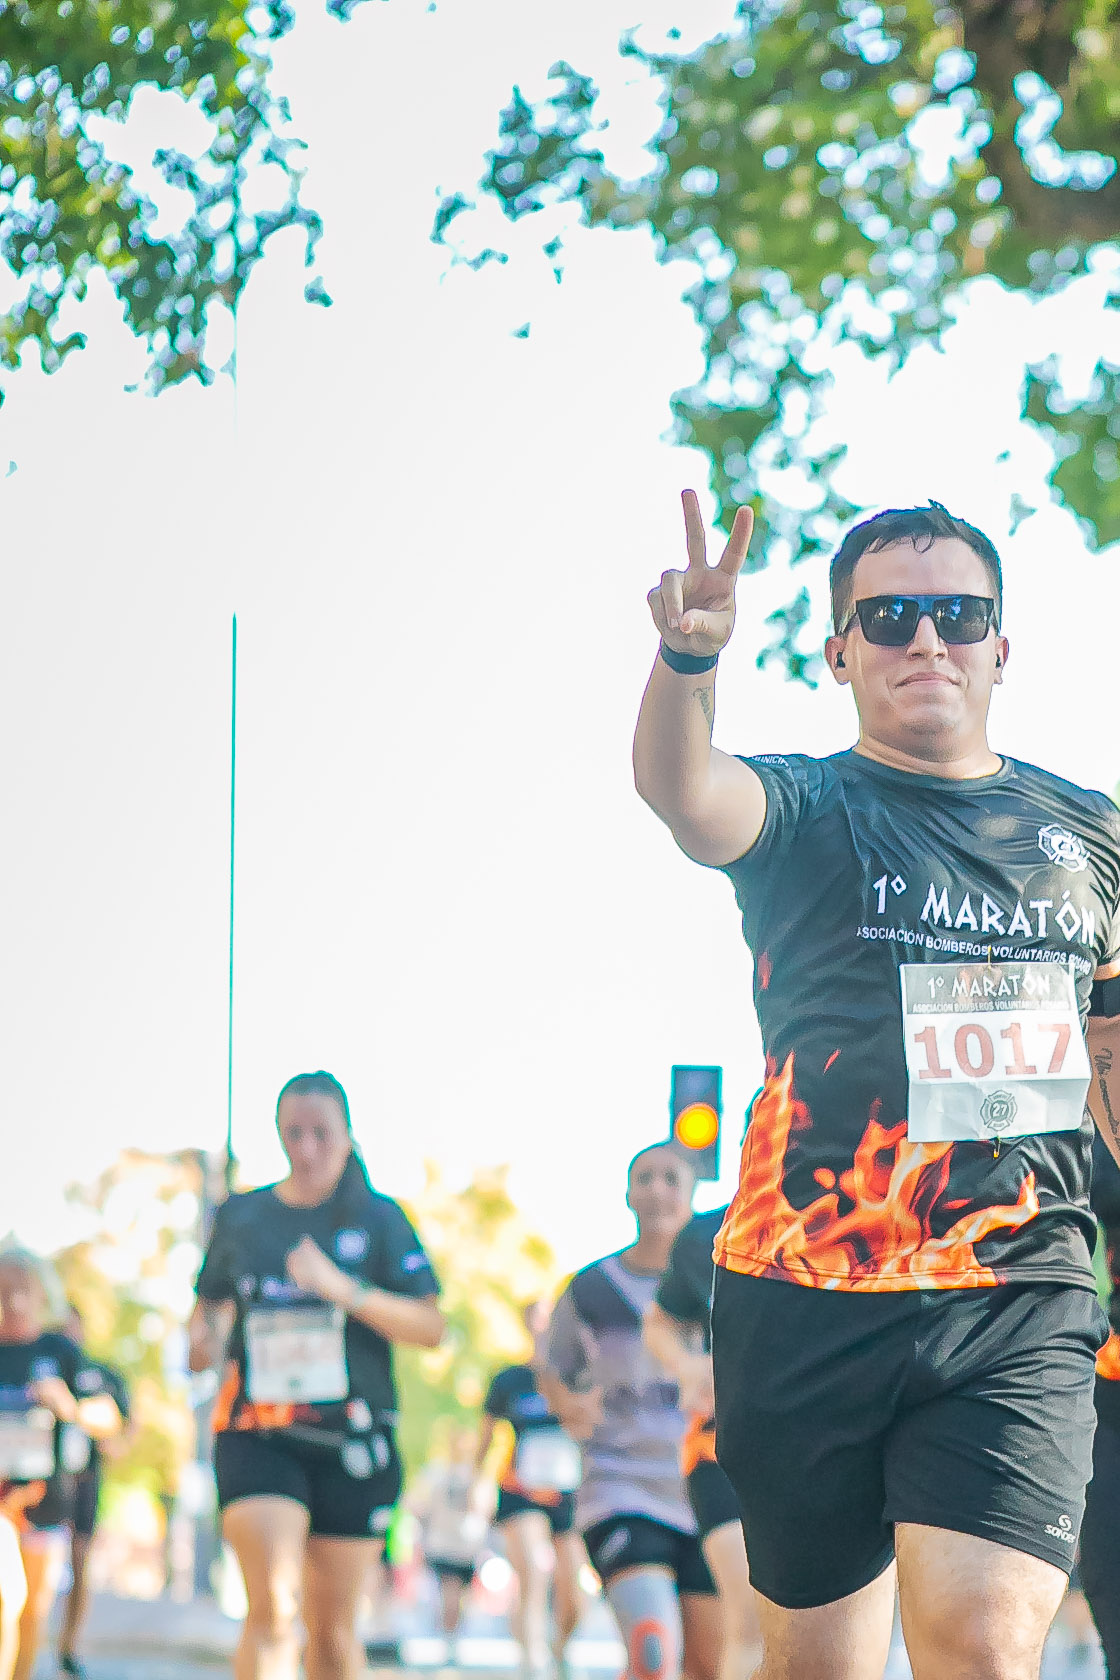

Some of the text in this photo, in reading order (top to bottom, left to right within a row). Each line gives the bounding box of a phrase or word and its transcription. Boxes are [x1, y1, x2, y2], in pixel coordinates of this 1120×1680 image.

[920, 882, 1095, 948] MARATÓN
[857, 927, 924, 946] ASOCIACIÓN
[926, 936, 989, 956] BOMBEROS
[992, 945, 1067, 964] VOLUNTARIOS
[914, 1022, 1071, 1079] 1017
[992, 1102, 1008, 1117] 27
